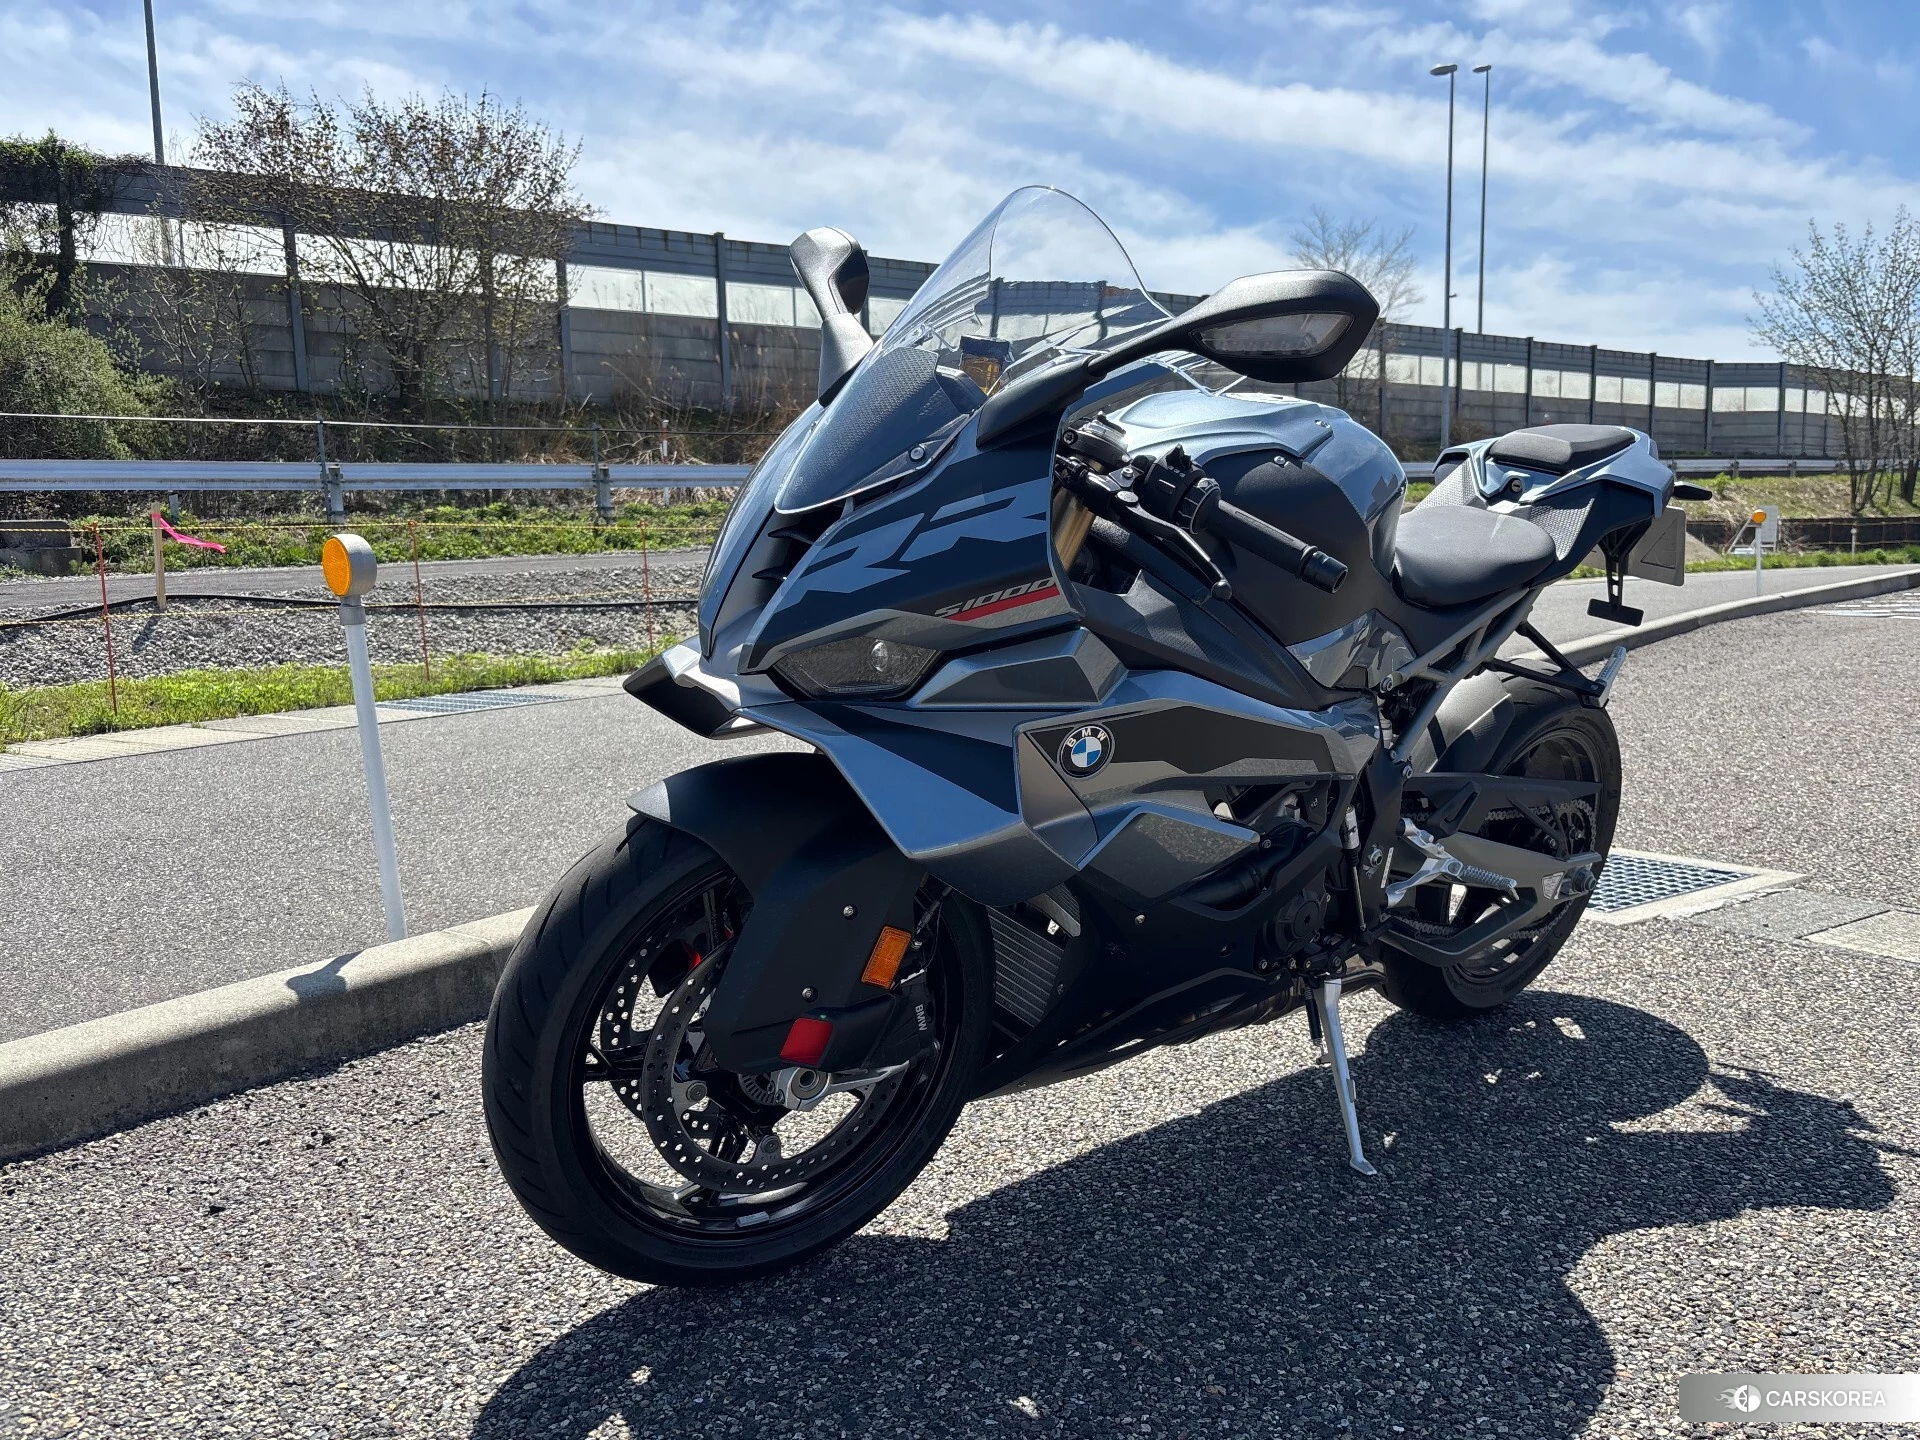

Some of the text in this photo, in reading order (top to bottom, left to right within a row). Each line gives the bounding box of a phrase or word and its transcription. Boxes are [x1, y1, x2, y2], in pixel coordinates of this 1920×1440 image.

[934, 577, 1057, 618] S1000
[1066, 727, 1107, 748] BMW
[915, 1003, 928, 1032] BMW
